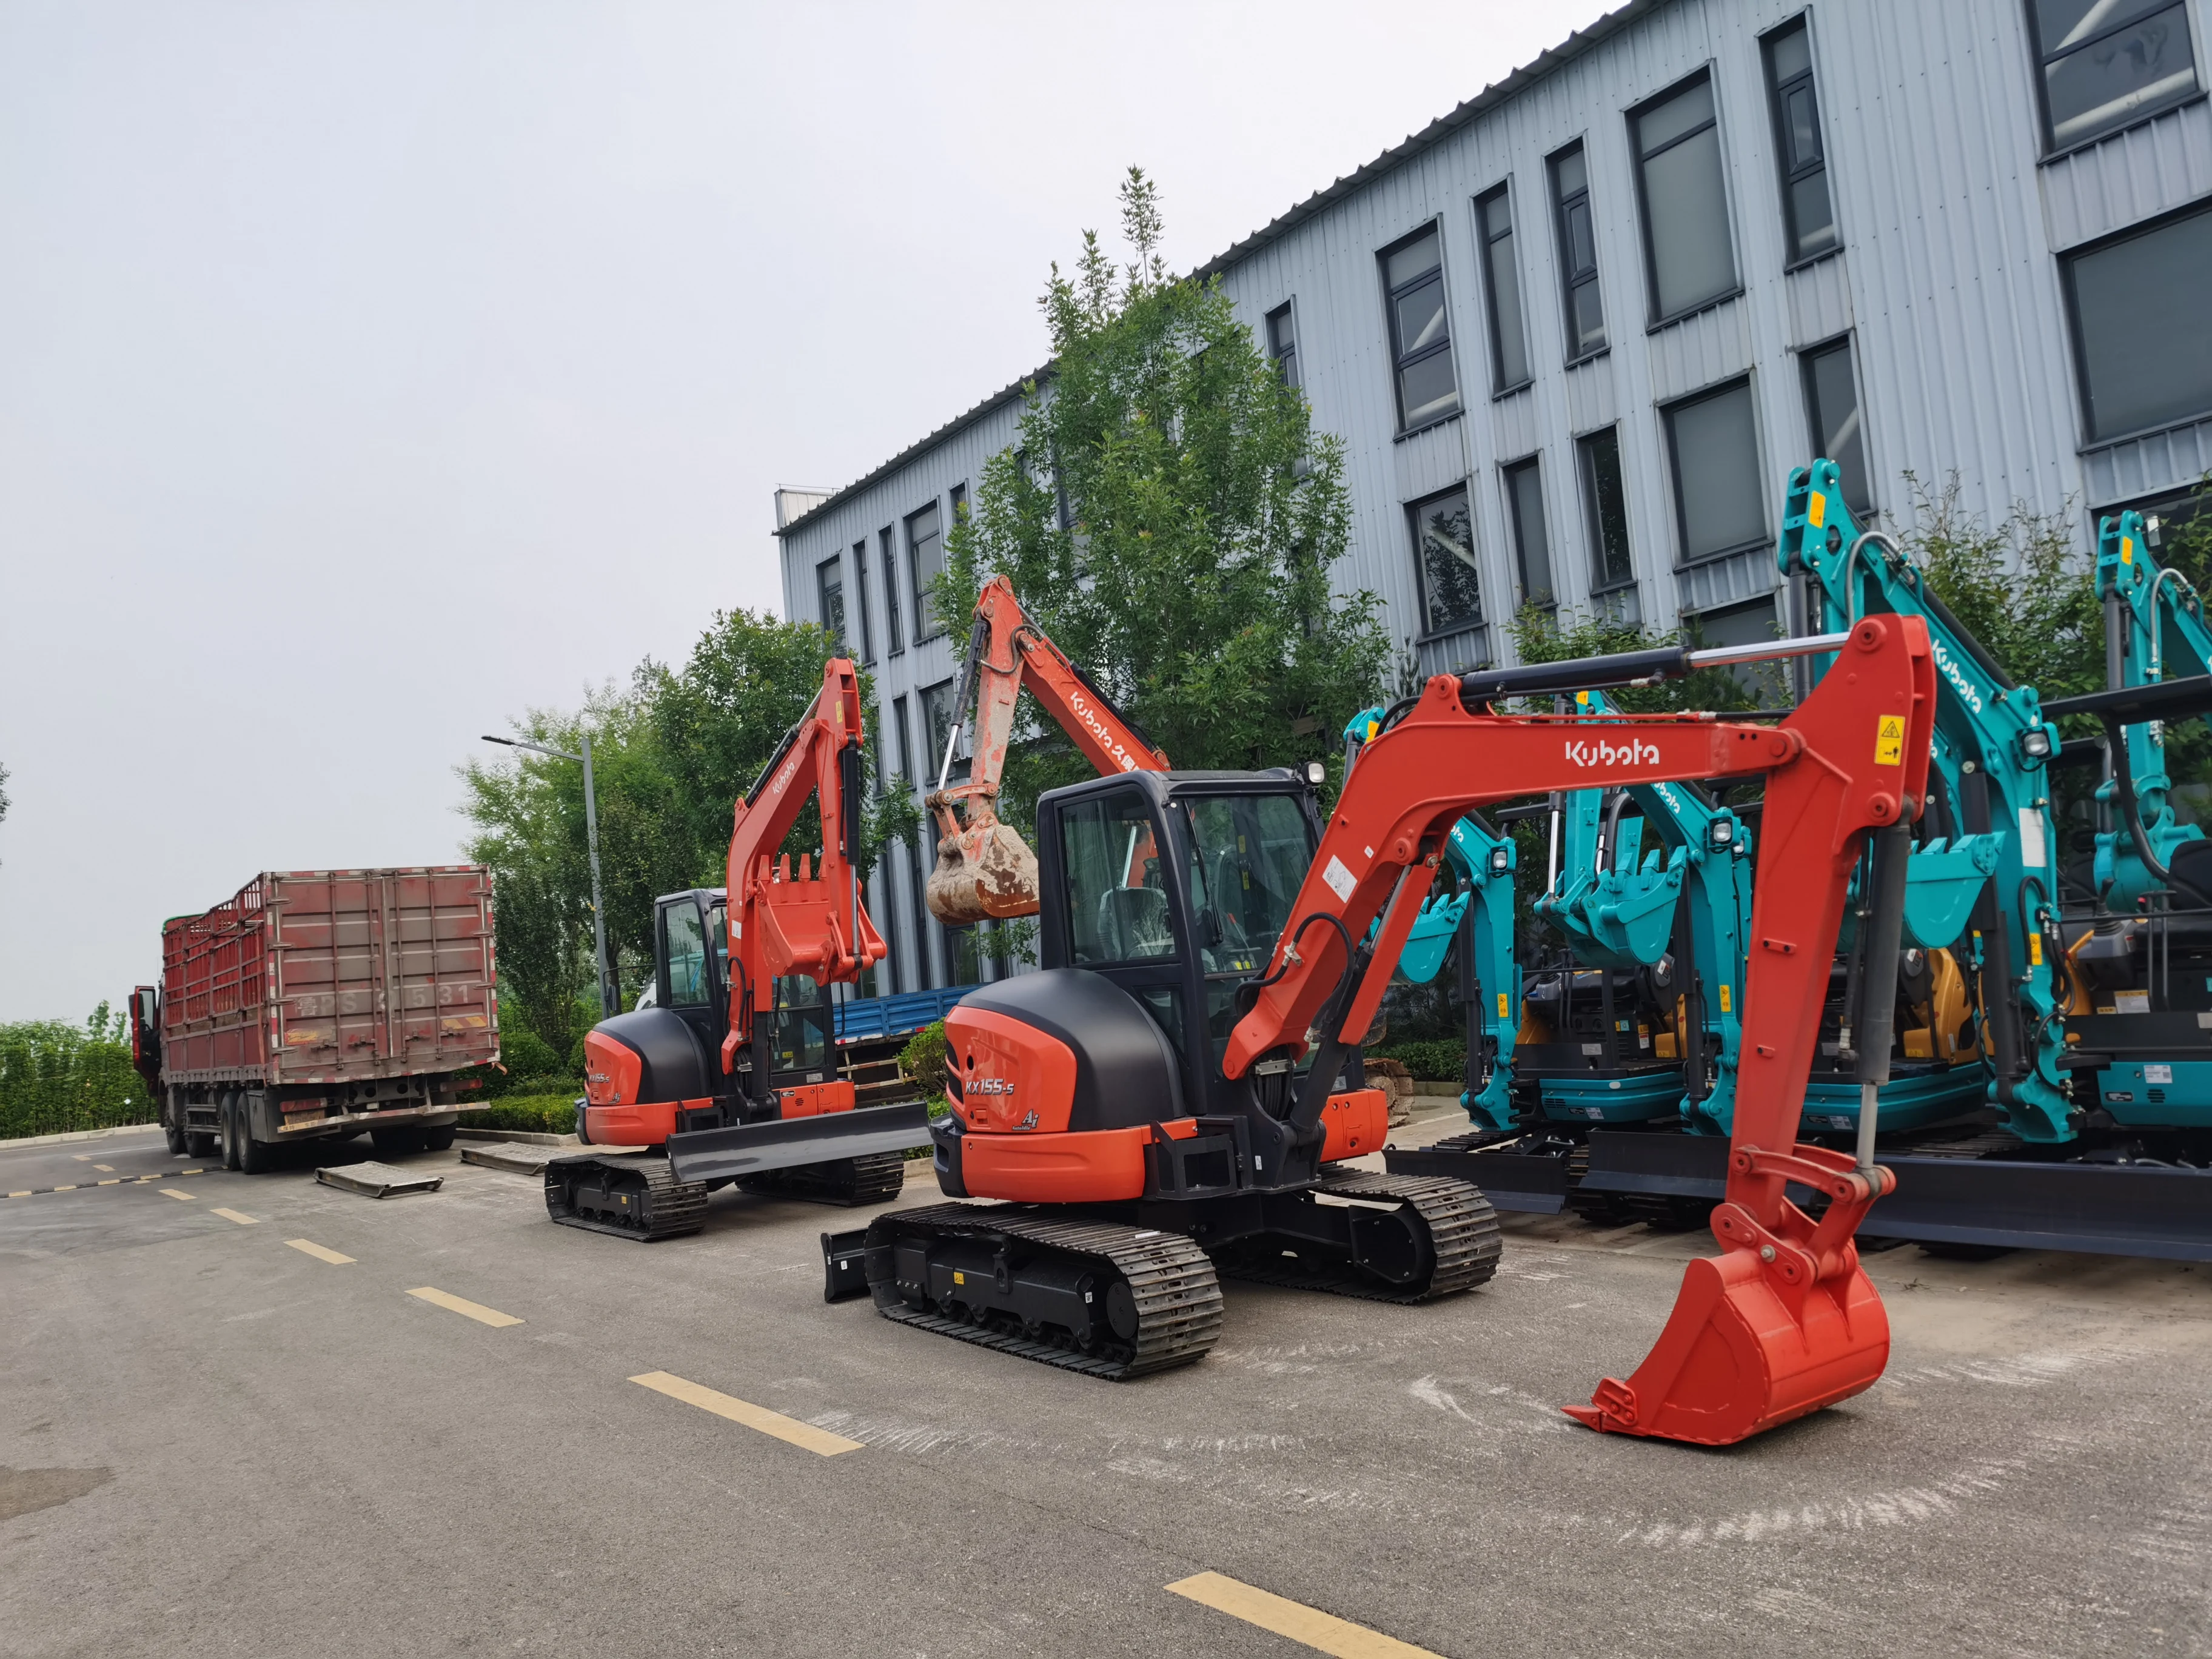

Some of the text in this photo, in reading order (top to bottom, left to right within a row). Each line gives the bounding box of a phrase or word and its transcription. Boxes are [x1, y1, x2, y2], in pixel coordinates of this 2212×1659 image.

[1932, 638, 1982, 714] Kubota
[1070, 691, 1140, 772] Kubota 久保
[1565, 738, 1660, 767] Kubota
[772, 762, 796, 794] Kubota
[965, 1078, 1015, 1095] KX155-5
[1022, 1108, 1040, 1129] Ai
